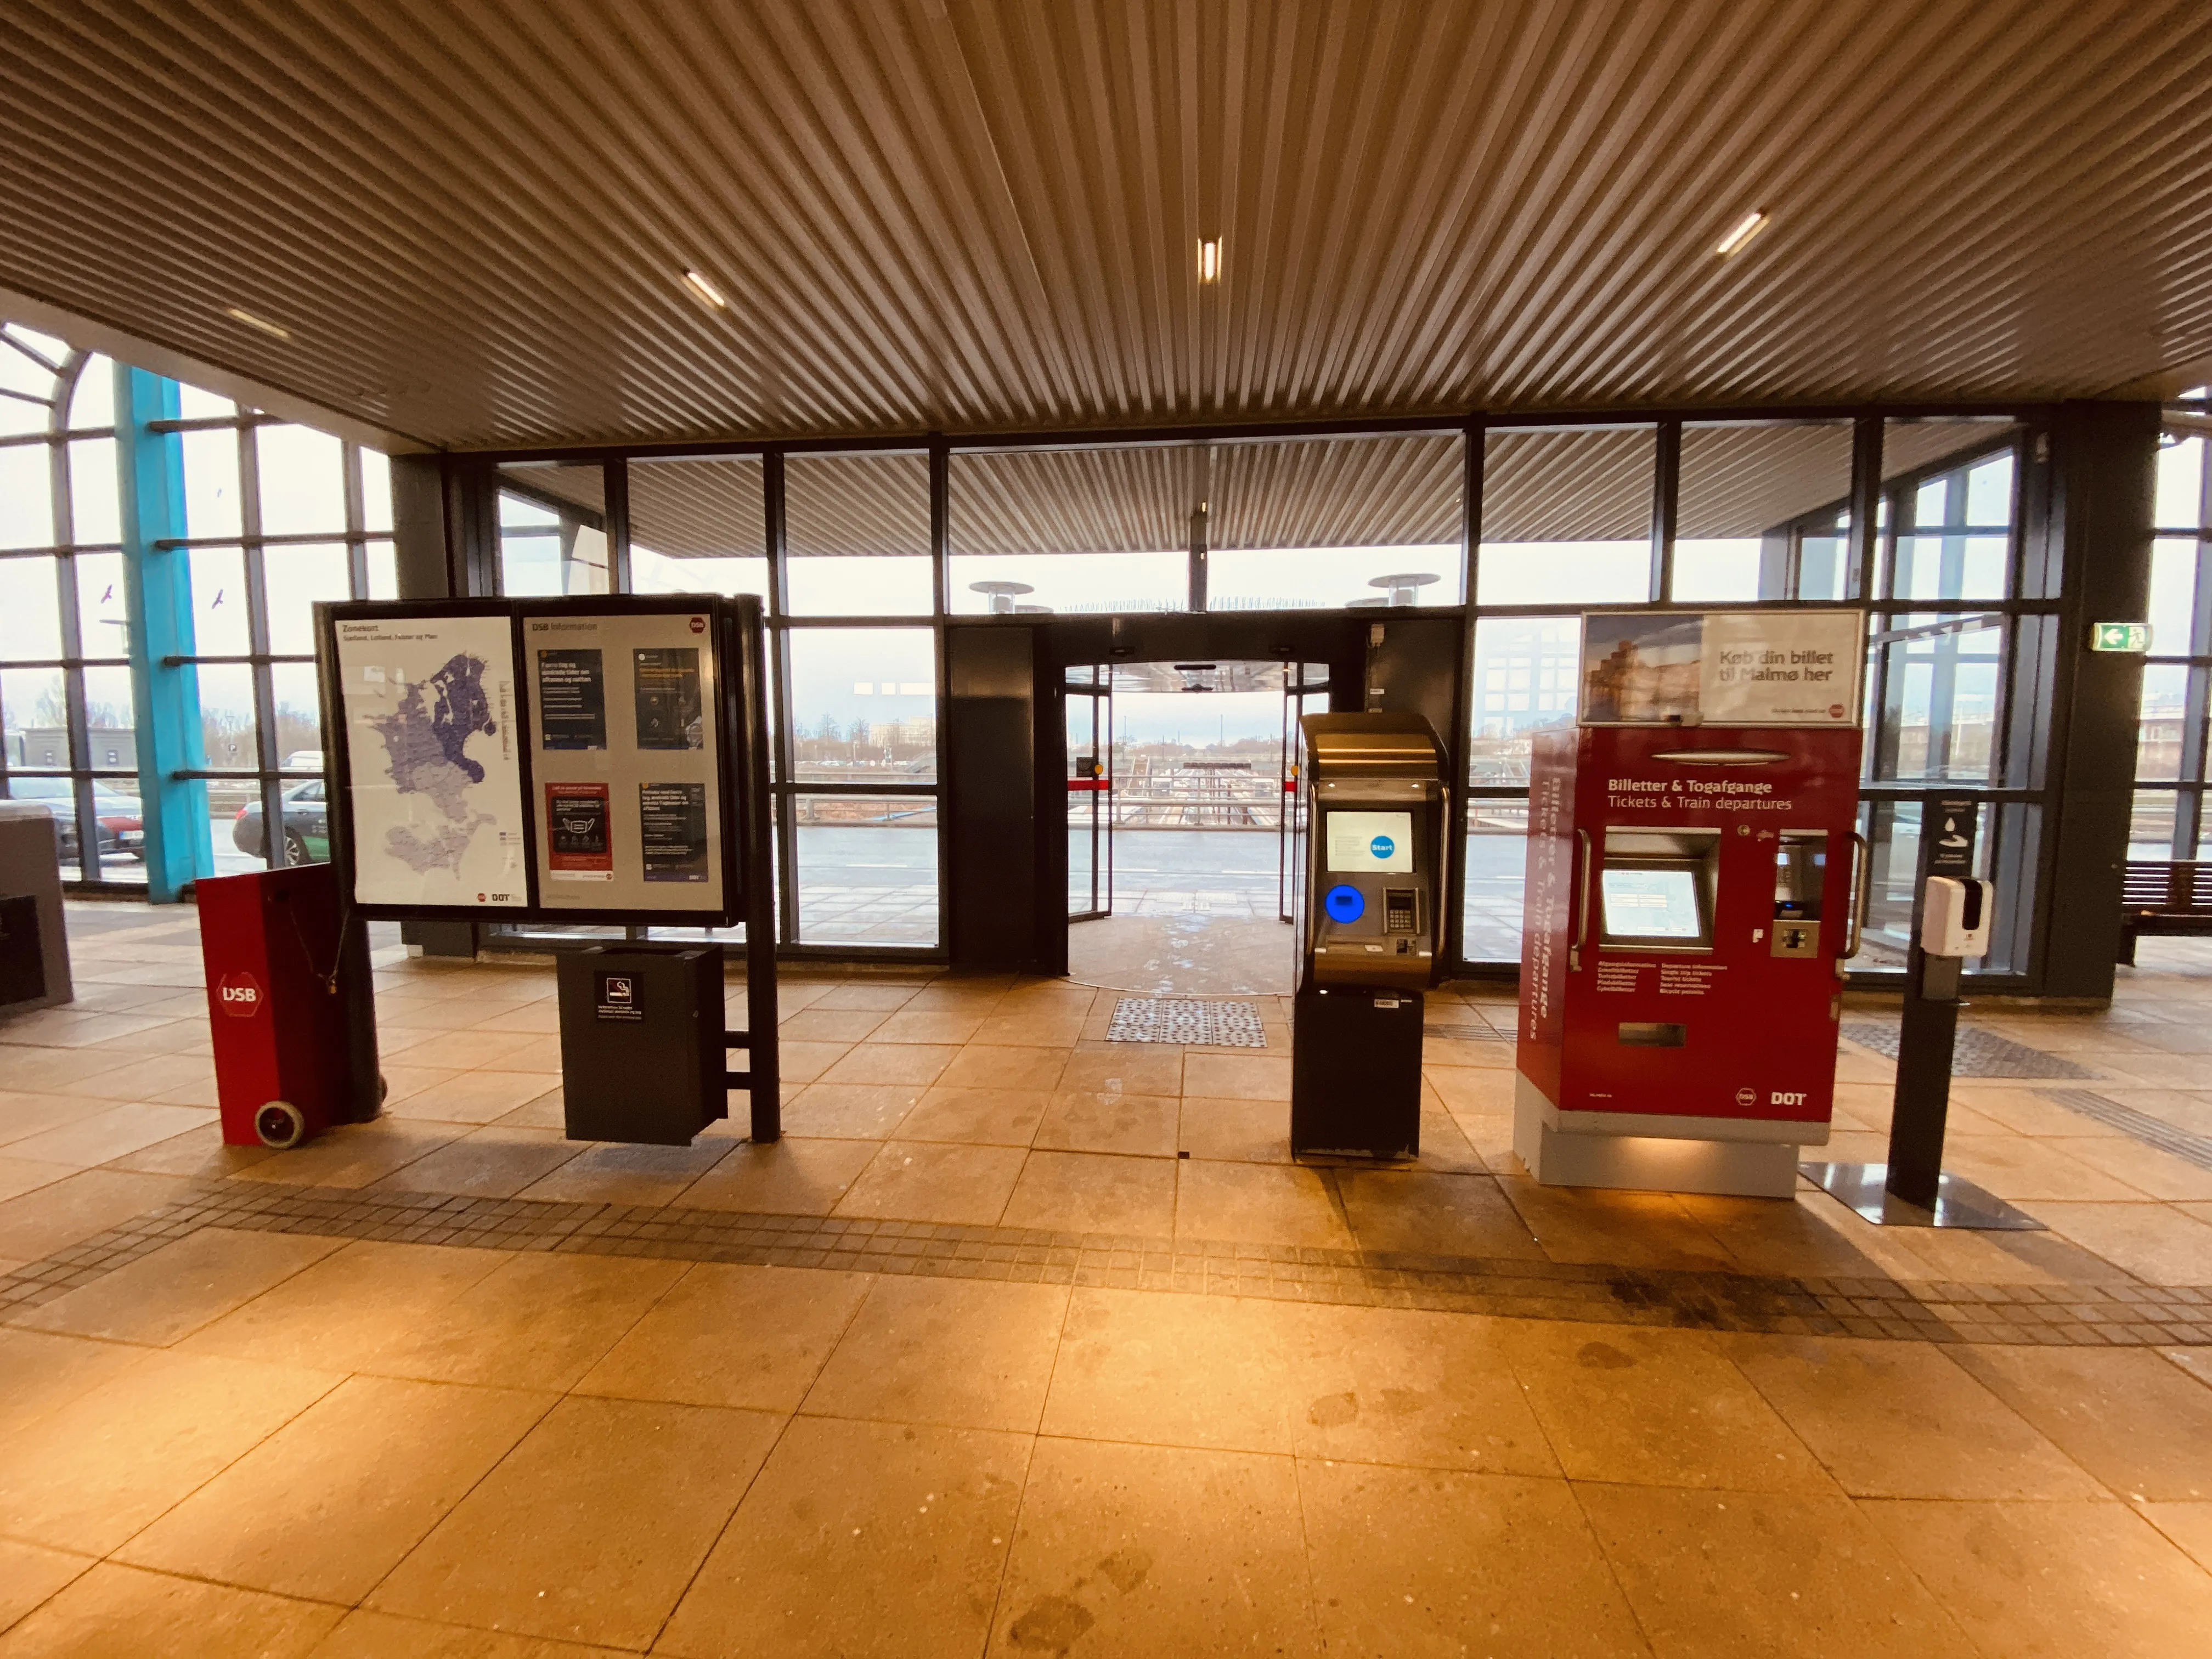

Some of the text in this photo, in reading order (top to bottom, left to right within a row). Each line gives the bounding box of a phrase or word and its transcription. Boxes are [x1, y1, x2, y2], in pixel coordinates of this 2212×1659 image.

[550, 622, 597, 630] Information
[1720, 650, 1833, 664] Køb din billet
[1720, 667, 1833, 681] til Malmø her
[1608, 779, 1773, 795] Billetter & Togafgange
[1608, 795, 1792, 811] Tickets & Train departures
[1541, 777, 1561, 1019] Billetter & Togafgange
[1529, 780, 1550, 1041] Tickets & Train departures
[223, 987, 256, 1002] DSB
[1771, 1092, 1807, 1105] DOT
